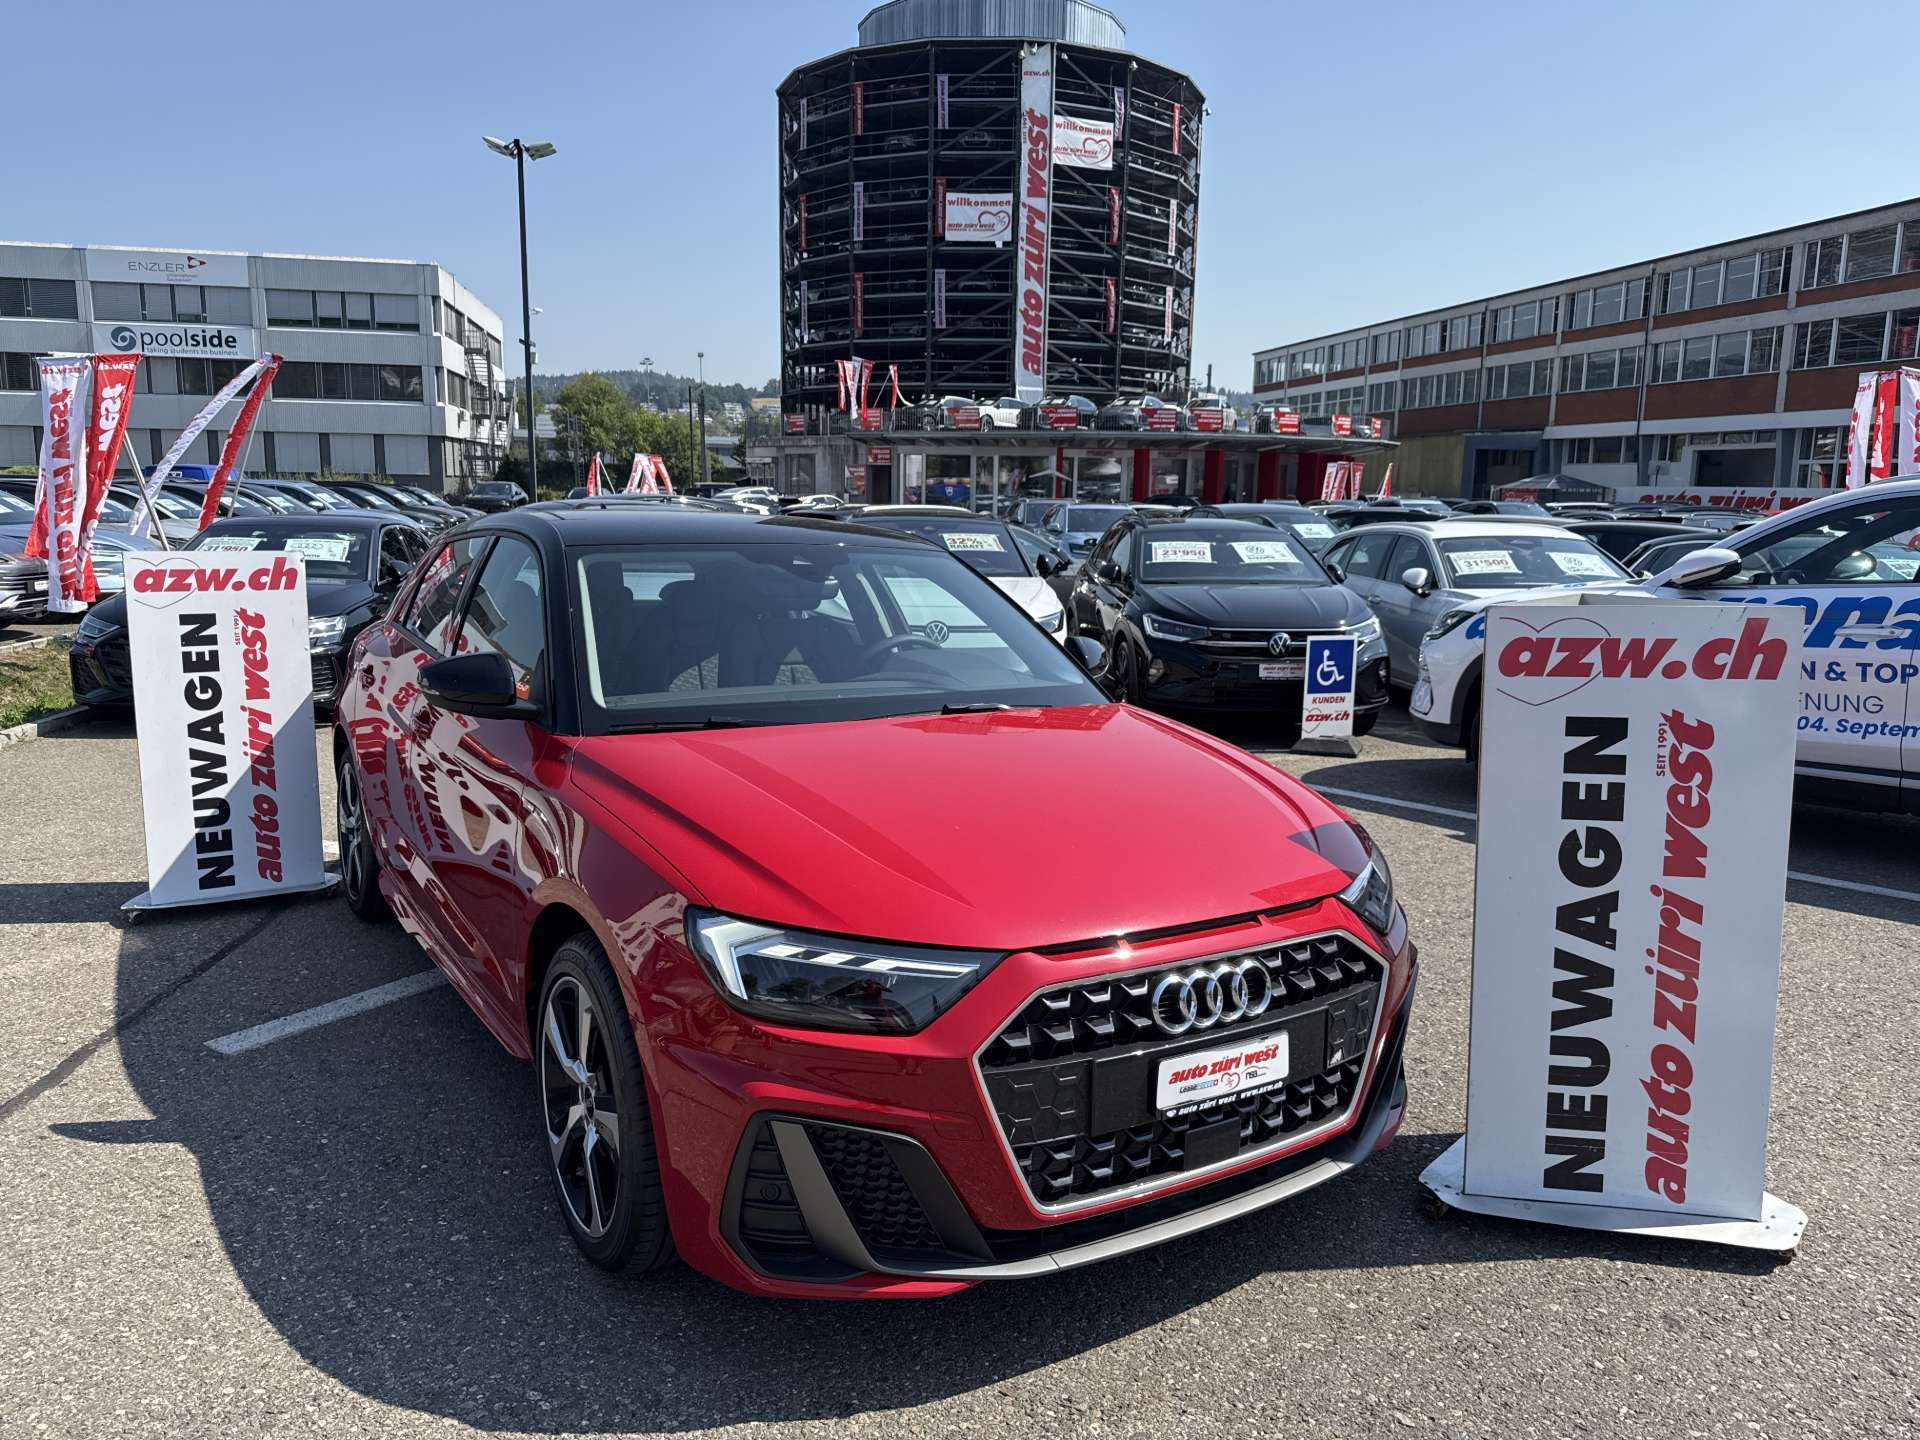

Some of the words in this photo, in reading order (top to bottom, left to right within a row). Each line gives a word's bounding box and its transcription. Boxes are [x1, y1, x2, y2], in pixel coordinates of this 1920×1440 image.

[1055, 121, 1112, 135] willkommen
[1026, 107, 1049, 199] west
[947, 197, 1011, 207] willkommen
[1021, 202, 1047, 288] züri
[128, 261, 185, 272] ENZLER
[140, 329, 238, 352] poolside
[1019, 288, 1043, 376] auto
[209, 348, 239, 356] business
[947, 537, 983, 545] 32%
[132, 556, 298, 594] azw.ch
[1463, 559, 1509, 568] 31'500
[234, 607, 271, 700] west
[1498, 617, 1788, 681] azw.ch
[1824, 661, 1847, 682] &
[1856, 662, 1919, 684] TOP
[1305, 710, 1350, 722] azw.ch
[1312, 696, 1345, 704] KUNDEN
[1799, 692, 1884, 714] NUNG
[178, 612, 236, 891] NEUWAGEN
[240, 704, 277, 792] züri
[1656, 721, 1668, 751] 1991
[1656, 752, 1666, 777] SEIT
[1658, 708, 1716, 879] west
[248, 793, 283, 884] auto
[1543, 715, 1629, 1194] NEUWAGEN
[1644, 883, 1704, 1045] züri
[1169, 1064, 1208, 1085] auto
[1208, 1053, 1244, 1075] züri
[1244, 1043, 1279, 1066] west
[1178, 1104, 1198, 1115] auto
[1218, 1094, 1237, 1105] west
[1639, 1042, 1695, 1204] auto
